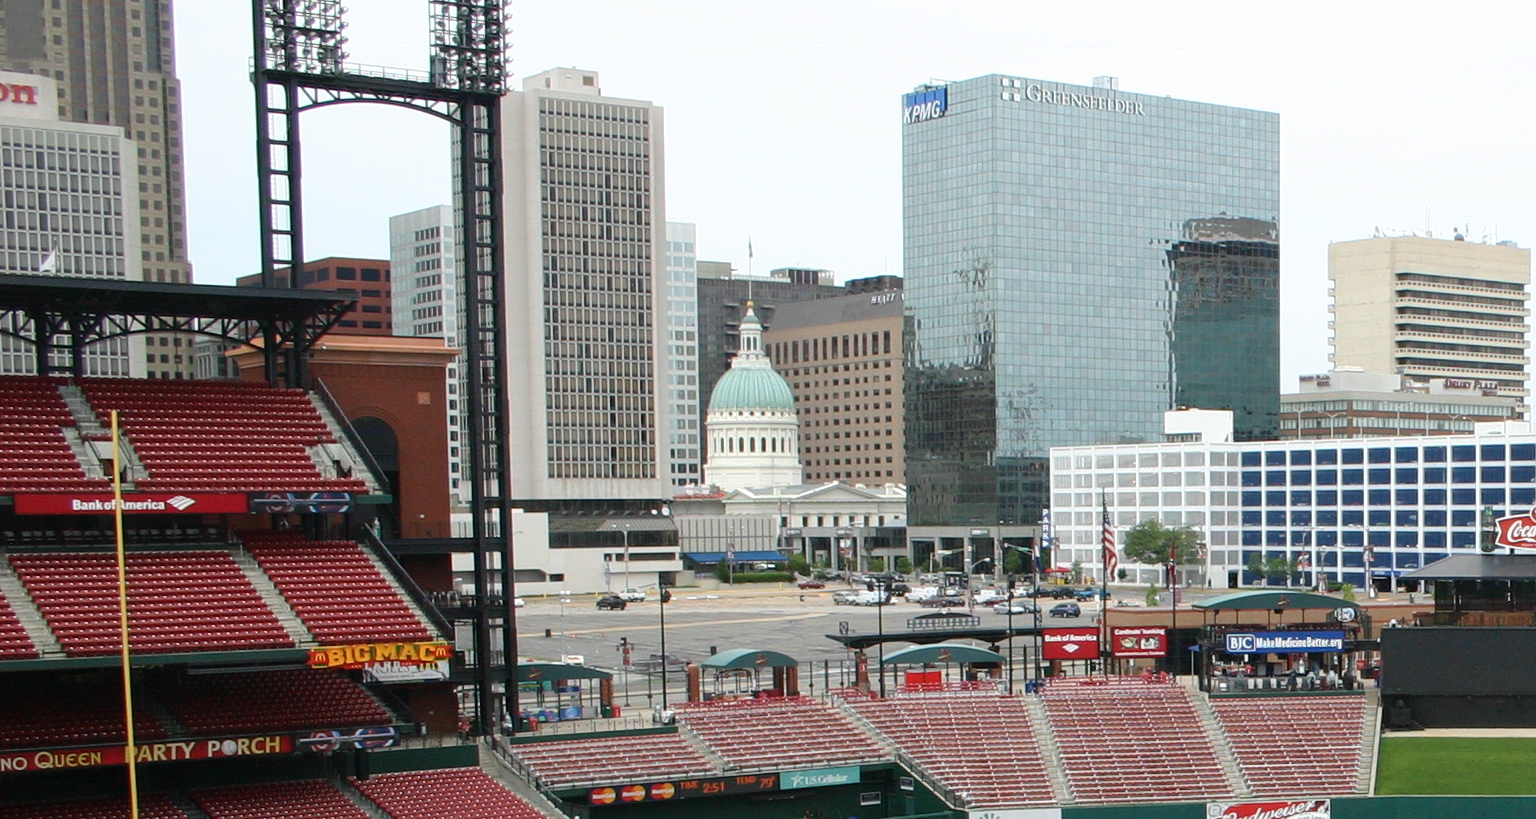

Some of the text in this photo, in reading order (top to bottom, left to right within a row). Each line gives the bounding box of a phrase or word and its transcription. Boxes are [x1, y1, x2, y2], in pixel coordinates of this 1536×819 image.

[903, 100, 942, 125] KPMG
[72, 499, 166, 510] Bank of America
[1042, 508, 1050, 540] PARK
[1230, 637, 1253, 649] BJC
[327, 644, 371, 668] BIG
[375, 642, 436, 662] MAC
[125, 742, 196, 763] PARTY
[702, 782, 726, 793] 2:51
